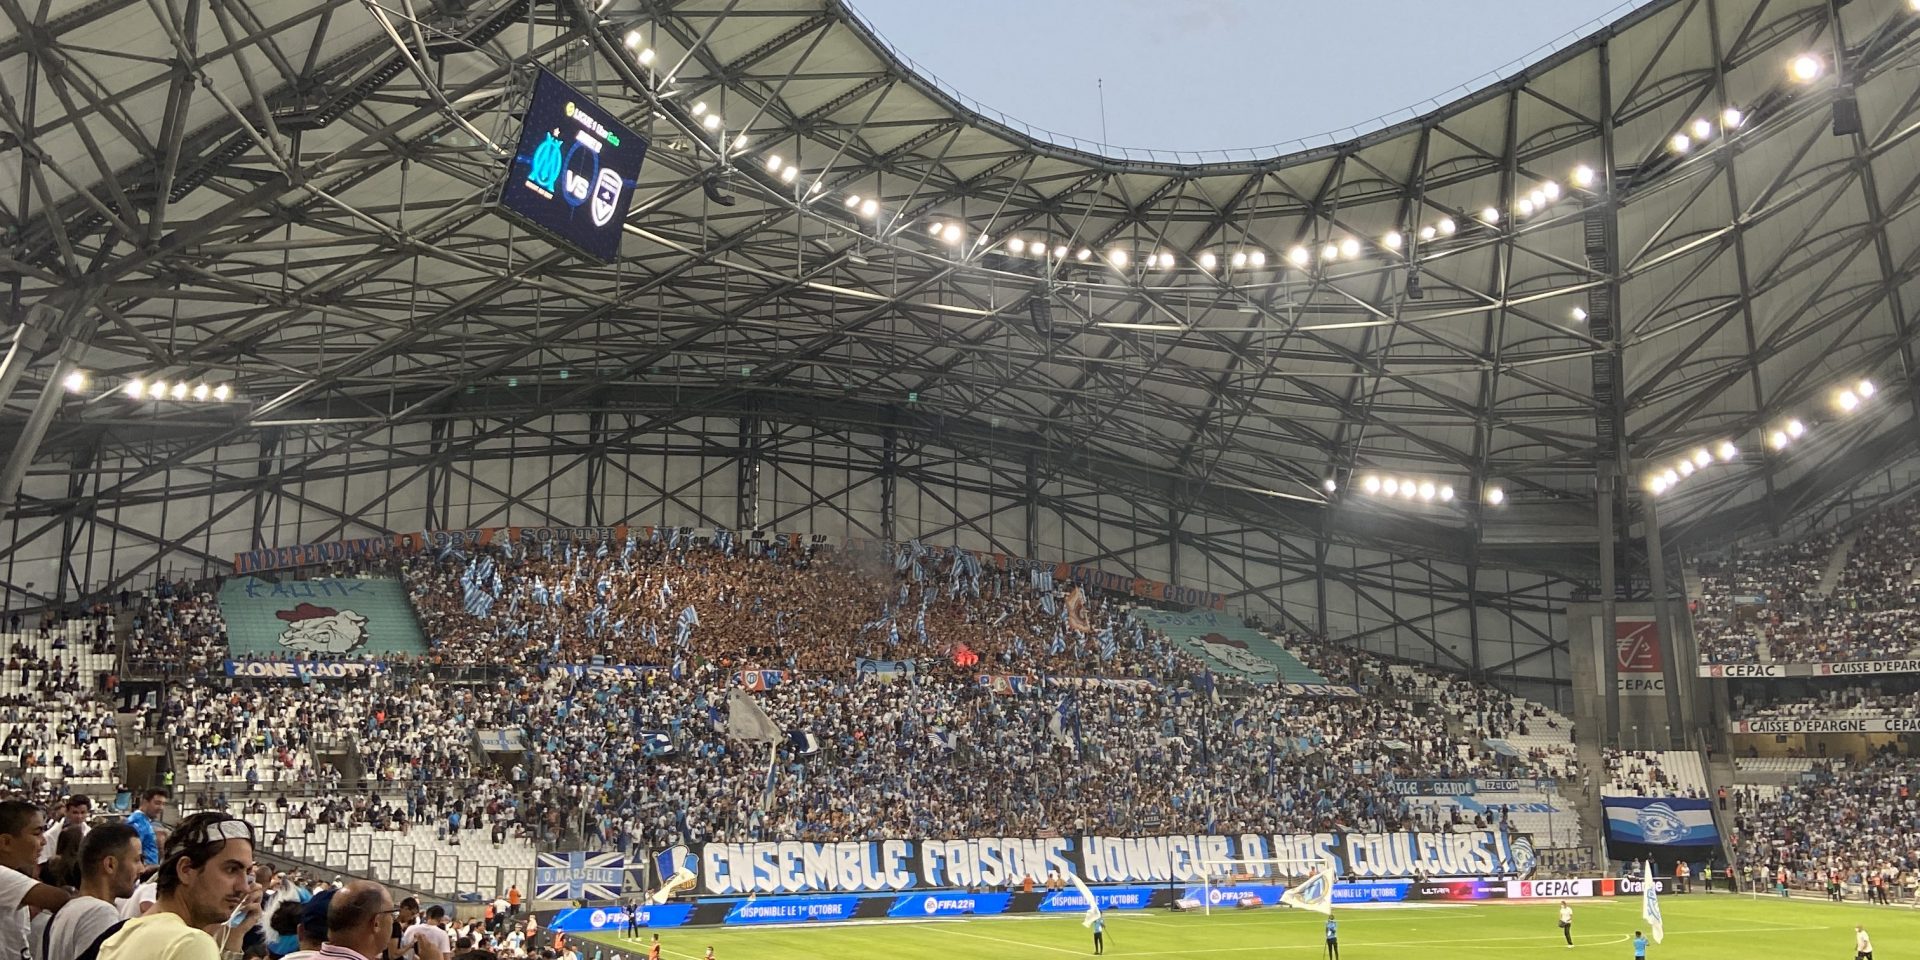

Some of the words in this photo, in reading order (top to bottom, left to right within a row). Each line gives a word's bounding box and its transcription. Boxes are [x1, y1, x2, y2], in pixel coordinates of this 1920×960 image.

[566, 169, 590, 200] VS
[1162, 584, 1220, 609] GROUP
[232, 662, 297, 677] ZONE
[1725, 665, 1775, 676] CEPAC
[1832, 662, 1869, 674] CAISSE
[1874, 660, 1920, 672] D'EPAR
[1750, 721, 1789, 732] CAISSE
[1794, 720, 1866, 731] D'EPARGNE
[1884, 720, 1920, 731] CEPA
[703, 841, 915, 894] ENSEMBLE
[1082, 834, 1236, 882] HONNEUR
[1241, 833, 1271, 877] A
[1273, 832, 1340, 877] NOS
[554, 868, 614, 883] MARSEILLE
[1355, 888, 1362, 898] LE
[1371, 887, 1397, 897] OCTOBRE
[1535, 881, 1579, 896] CEPAC
[1110, 894, 1139, 905] OCTOBRE
[740, 905, 785, 918] DISPONIBLE
[787, 904, 796, 916] LE
[808, 903, 842, 915] OCTOBRE
